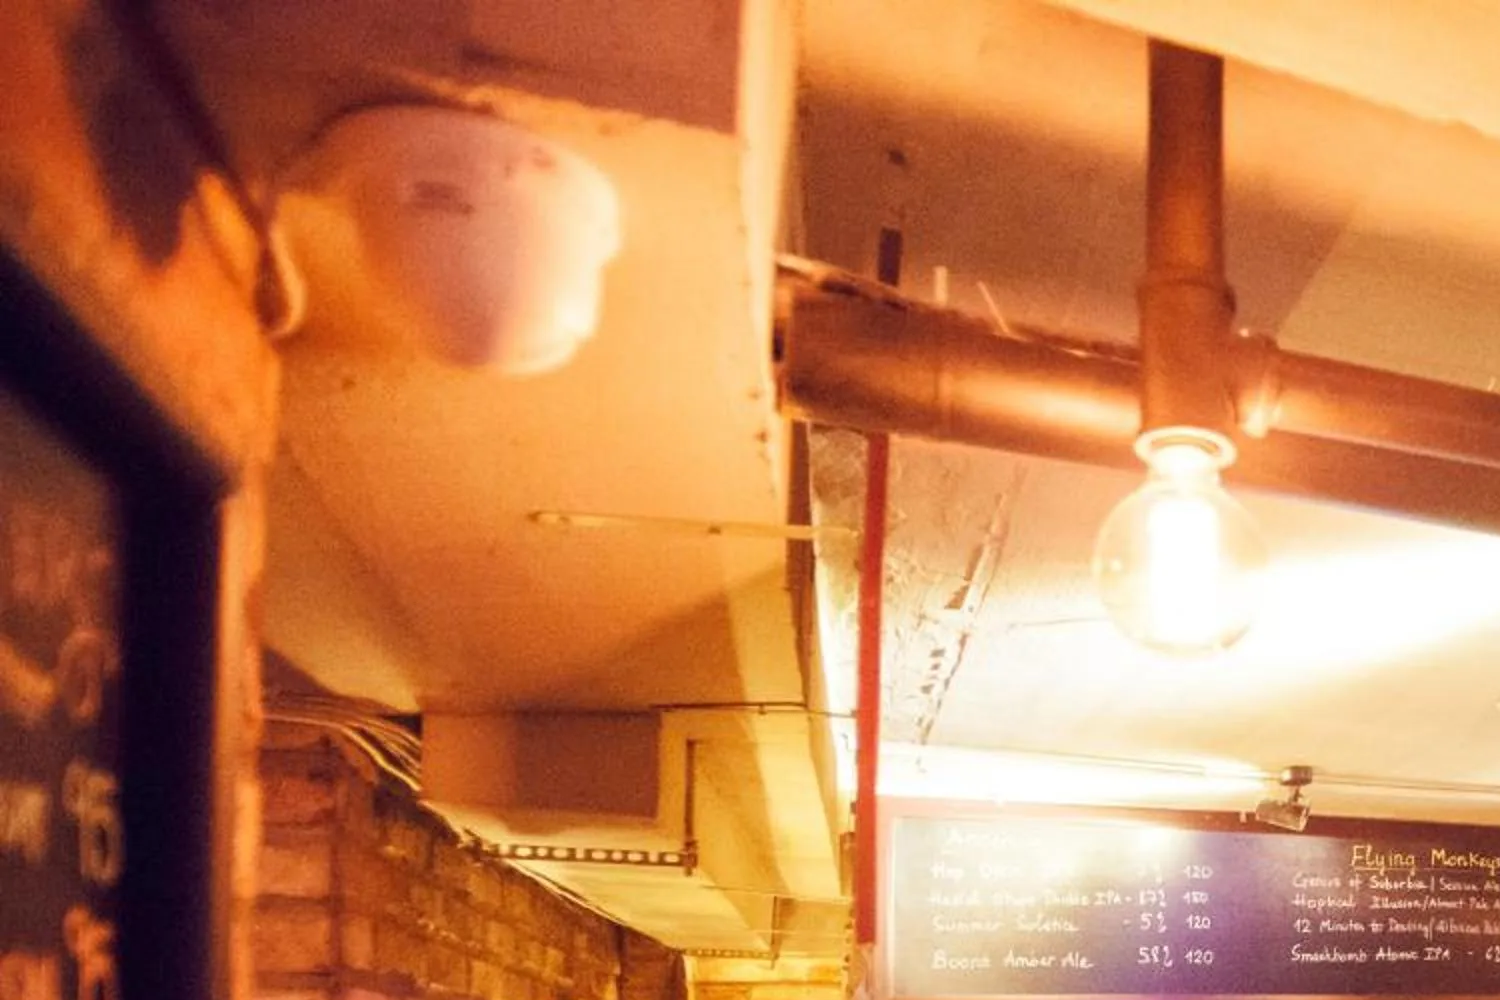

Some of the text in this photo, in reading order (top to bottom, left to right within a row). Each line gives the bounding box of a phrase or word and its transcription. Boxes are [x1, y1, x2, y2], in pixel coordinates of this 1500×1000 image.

[1350, 844, 1416, 877] Flying
[1186, 914, 1212, 930] 120
[1293, 918, 1312, 934] 12
[1061, 951, 1095, 970] Ale
[1184, 947, 1214, 966] 120
